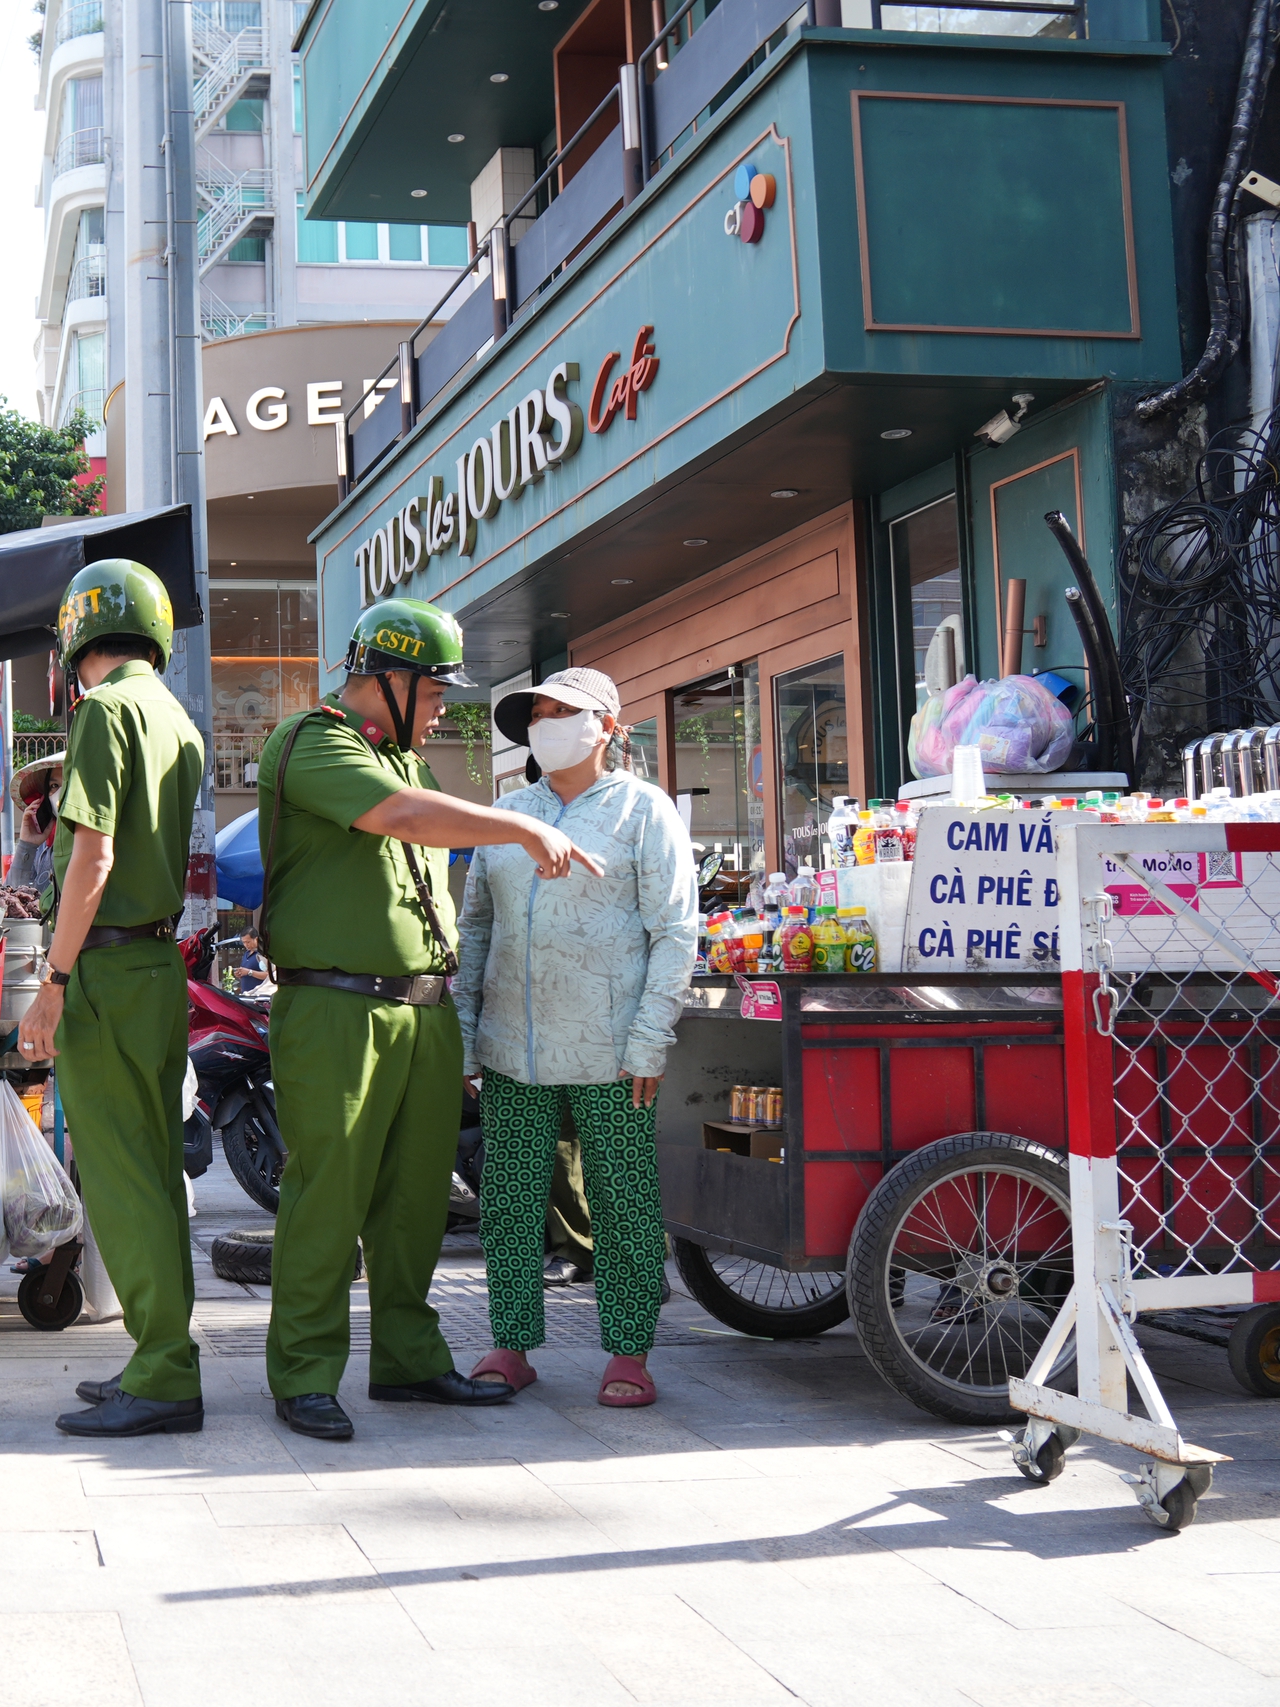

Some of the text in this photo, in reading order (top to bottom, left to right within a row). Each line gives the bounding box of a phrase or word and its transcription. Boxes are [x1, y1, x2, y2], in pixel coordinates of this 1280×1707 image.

[353, 325, 660, 610] TOUS les JOURS Café
[376, 628, 425, 657] CSTT
[792, 825, 811, 840] TOUS
[818, 824, 829, 838] JOU
[947, 811, 1057, 853] CAM VẮ
[1143, 858, 1192, 872] MoMo
[930, 867, 1058, 907] CÀ PHÊ Đ
[918, 920, 955, 957] CÀ
[967, 922, 1021, 959] PHÊ
[850, 944, 875, 971] C2
